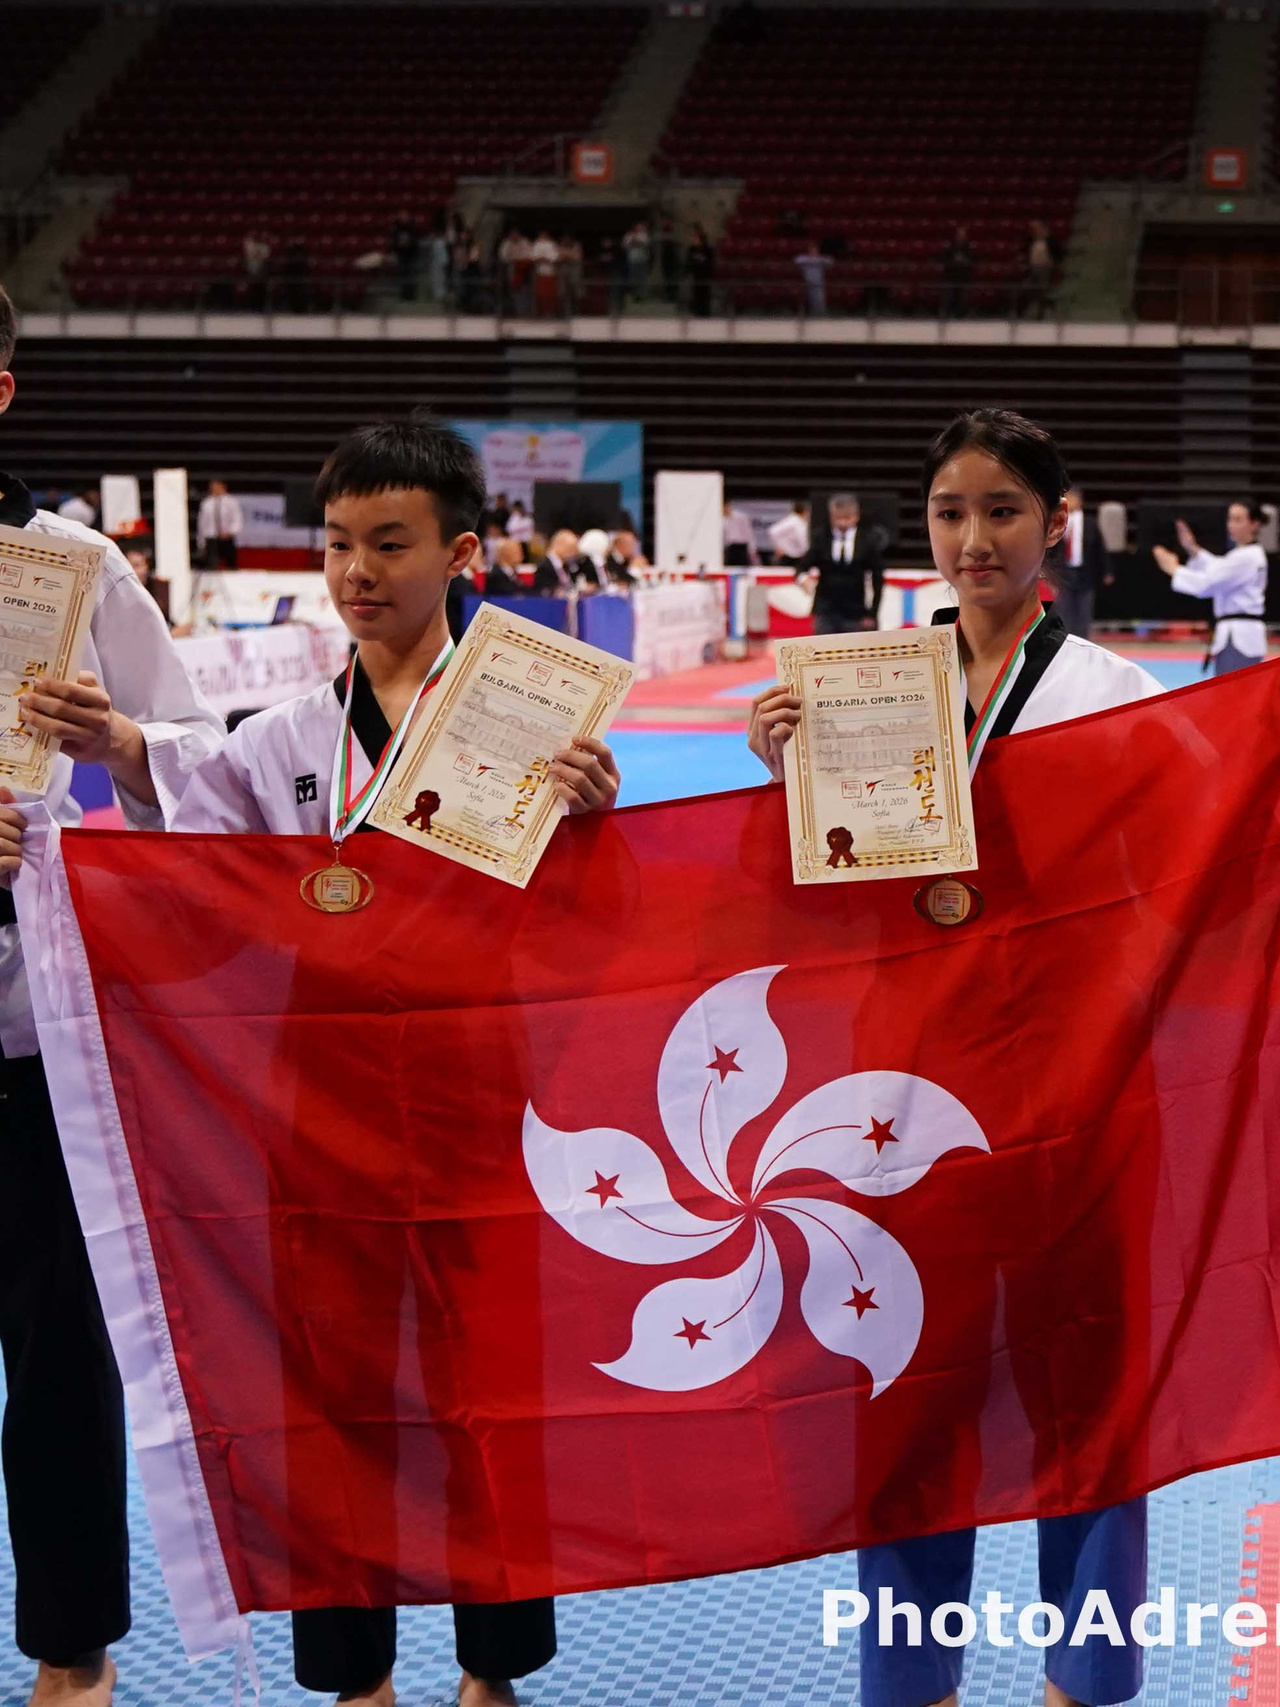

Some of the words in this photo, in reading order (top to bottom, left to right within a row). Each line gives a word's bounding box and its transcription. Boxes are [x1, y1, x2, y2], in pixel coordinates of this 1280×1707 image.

[3, 596, 31, 608] OPEN
[32, 602, 57, 614] 2026
[480, 672, 525, 696] BULGARIA
[527, 691, 553, 707] OPEN
[553, 702, 576, 717] 2026
[817, 698, 867, 708] BULGARIA
[870, 695, 897, 704] OPEN
[900, 693, 925, 702] 2026
[852, 799, 879, 809] March
[890, 797, 909, 806] 2026
[872, 810, 890, 820] Sofia
